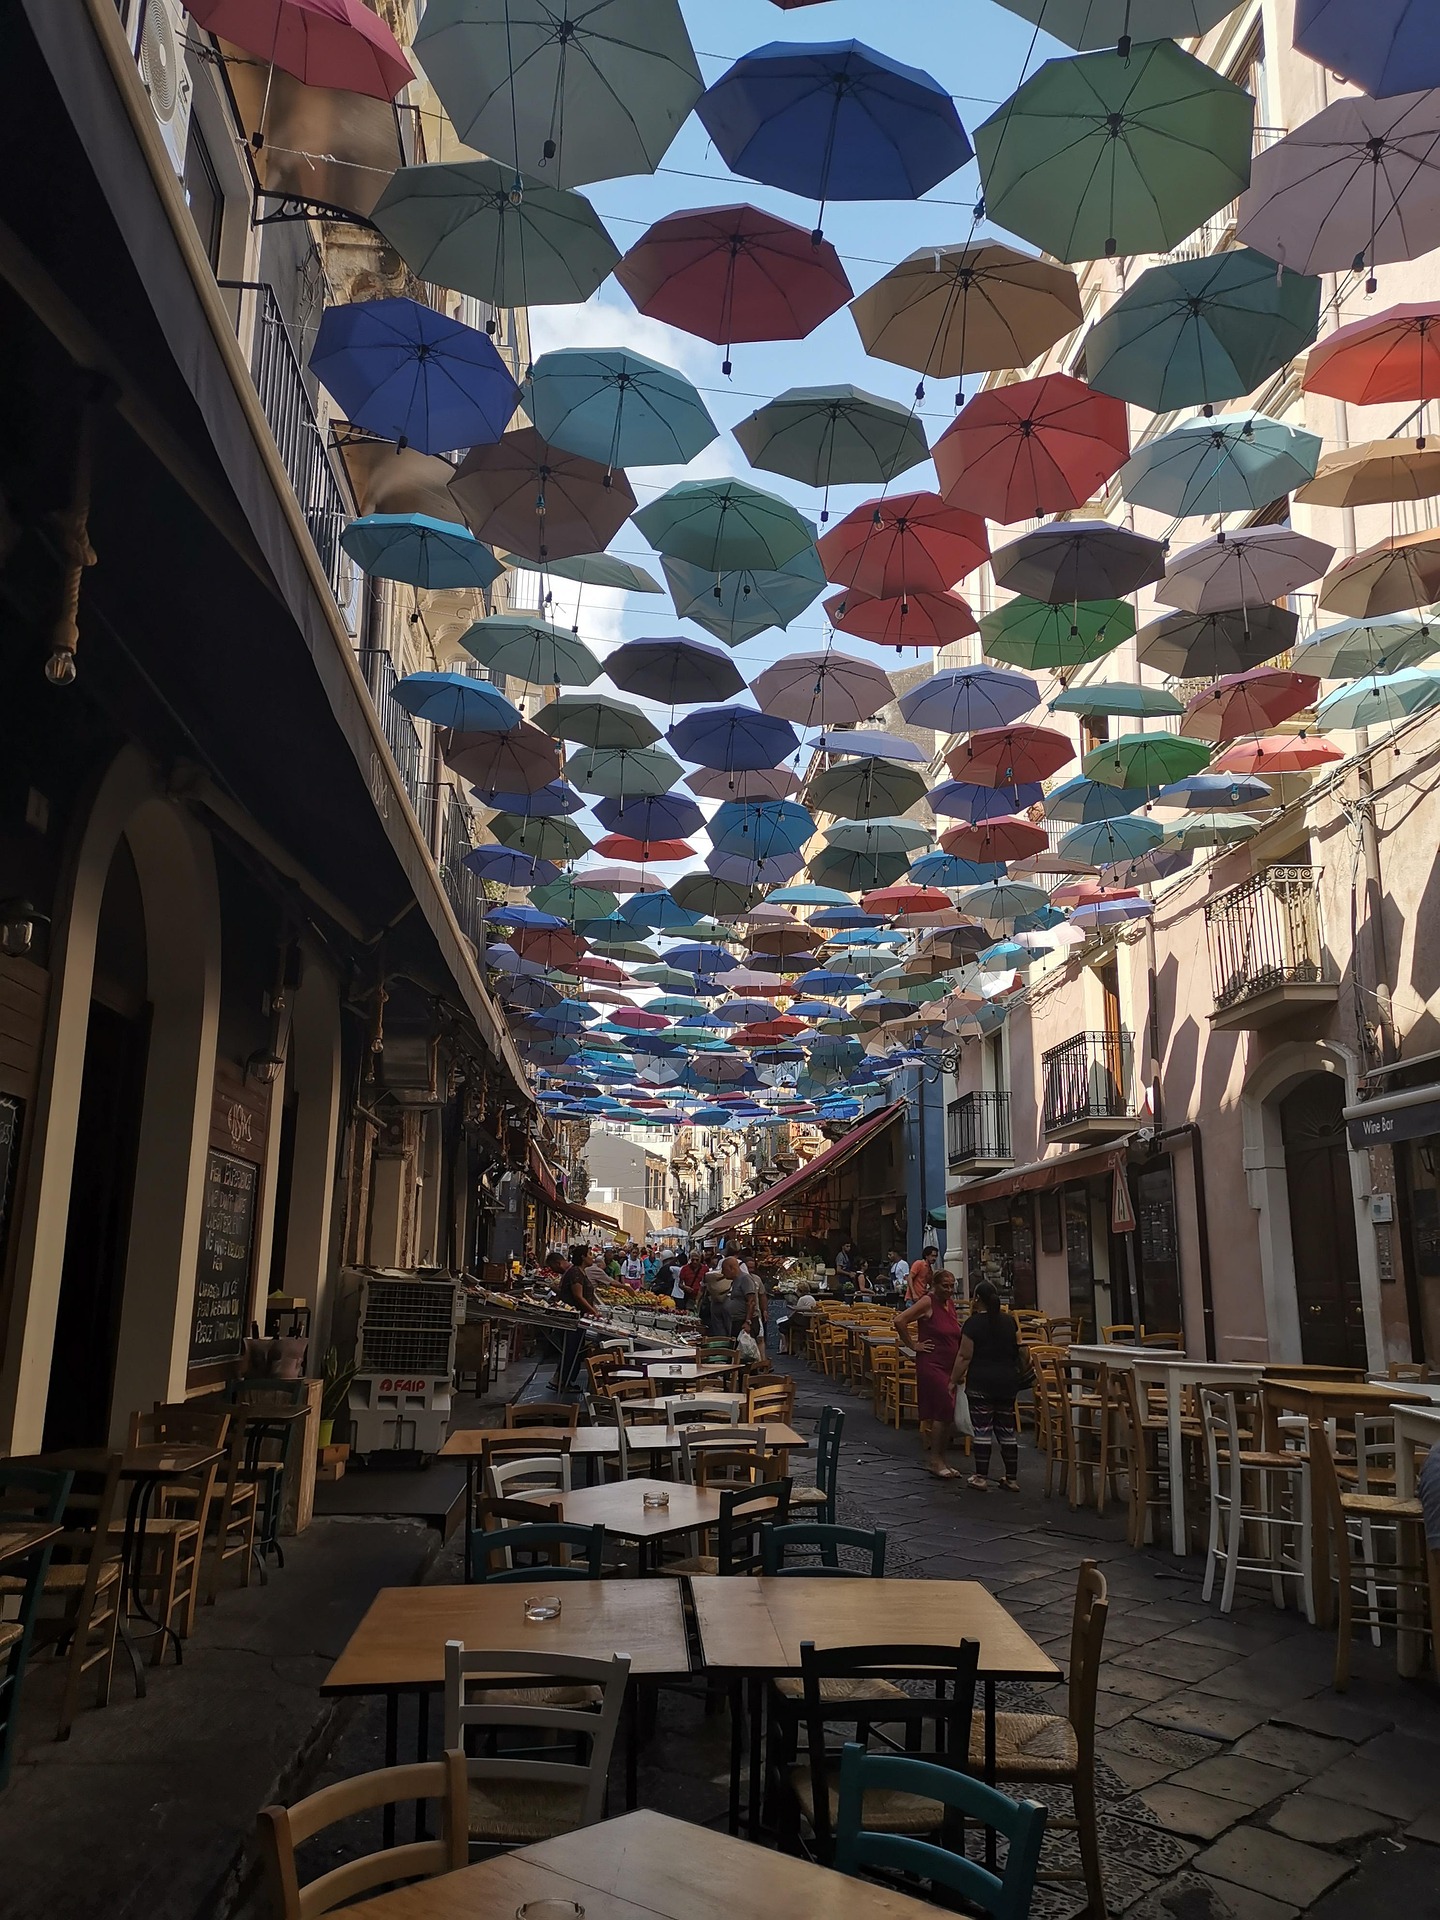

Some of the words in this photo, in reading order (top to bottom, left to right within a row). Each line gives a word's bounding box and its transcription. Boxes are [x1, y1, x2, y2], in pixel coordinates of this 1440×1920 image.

[1362, 1119, 1380, 1135] Wine
[1382, 1116, 1394, 1132] Bar
[394, 1379, 426, 1392] FAIP
